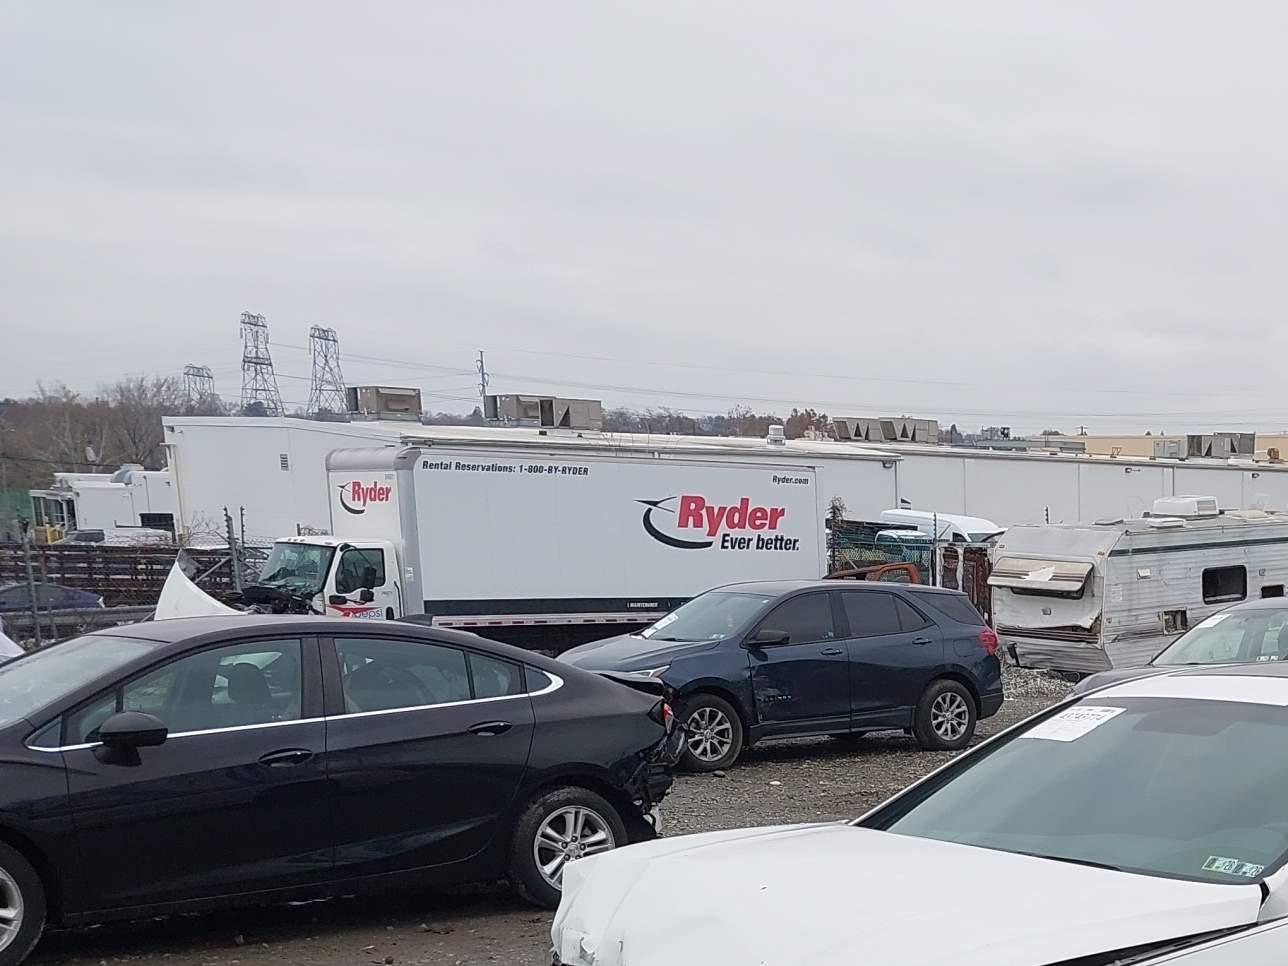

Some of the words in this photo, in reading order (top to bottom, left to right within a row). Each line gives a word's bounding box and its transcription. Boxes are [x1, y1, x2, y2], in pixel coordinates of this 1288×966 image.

[422, 460, 452, 470] Rental
[455, 461, 516, 473] Reservations:
[519, 464, 589, 476] 1-800-BY-RYDER
[772, 474, 809, 485] Ryder.com
[351, 481, 392, 507] Ryder
[677, 495, 786, 537] Ryder
[720, 533, 753, 550] Ever
[756, 534, 799, 551] better.
